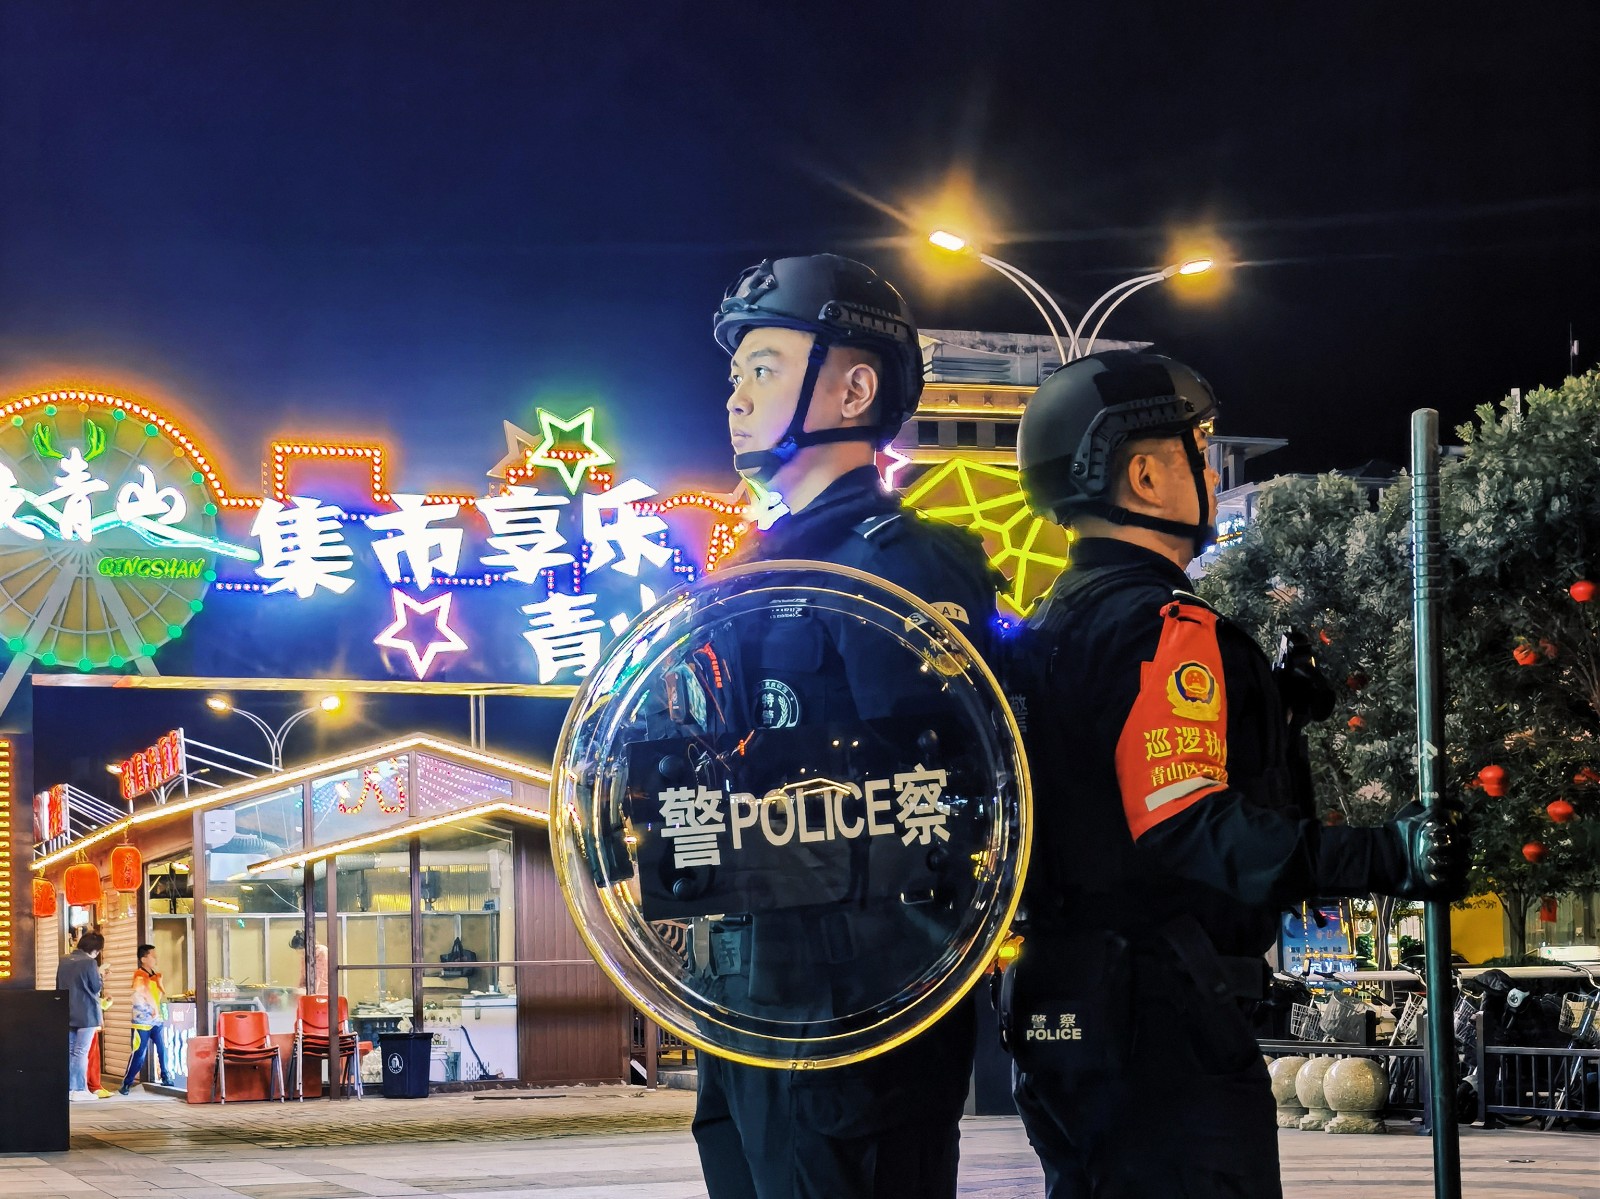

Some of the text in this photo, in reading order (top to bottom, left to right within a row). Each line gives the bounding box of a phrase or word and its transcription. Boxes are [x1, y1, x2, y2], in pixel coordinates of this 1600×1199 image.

[250, 478, 673, 597] 集市享乐
[97, 556, 205, 579] QINGSHAN
[909, 606, 963, 624] SAT
[1143, 726, 1227, 766] 巡逻执
[1026, 1028, 1082, 1041] POLICE
